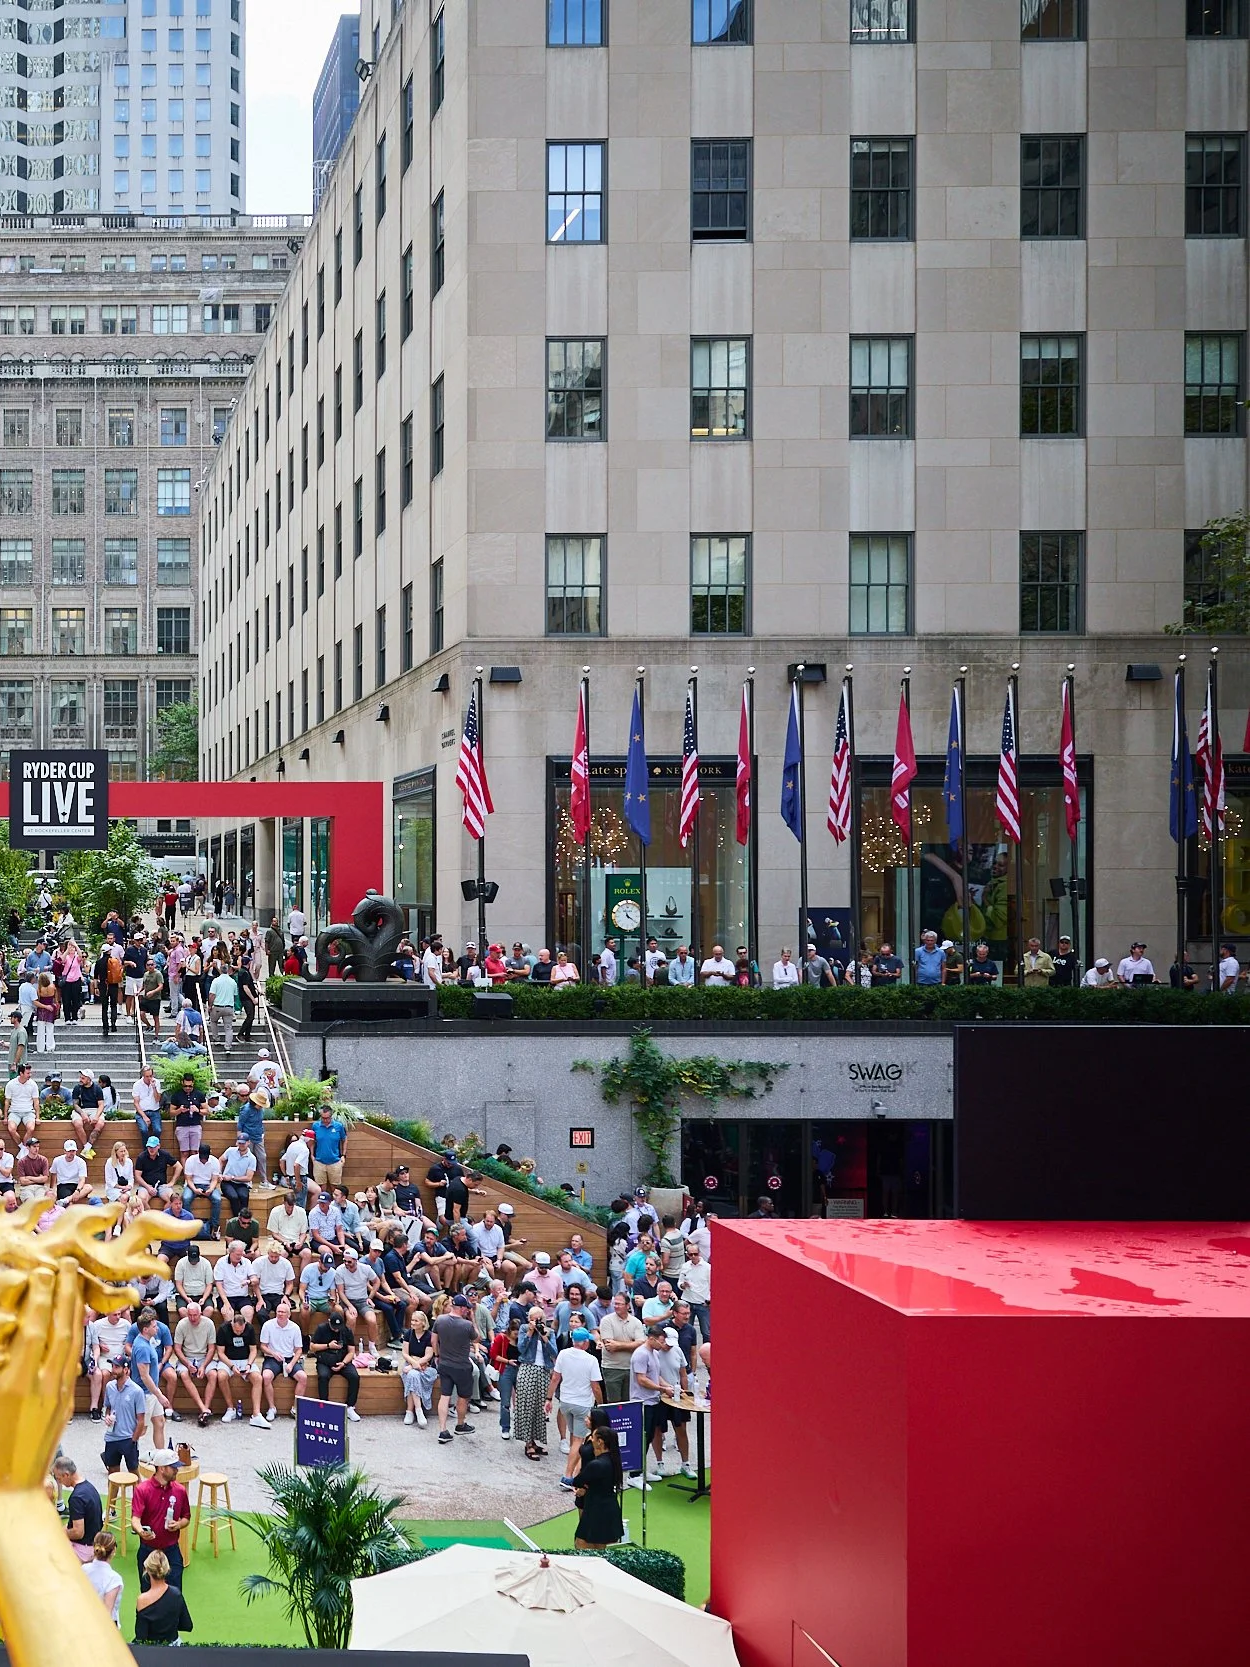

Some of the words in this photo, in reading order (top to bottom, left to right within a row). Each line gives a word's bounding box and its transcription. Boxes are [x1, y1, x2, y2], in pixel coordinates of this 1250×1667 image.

[23, 762, 67, 779] RYDER
[69, 762, 95, 779] CUP
[666, 767, 682, 775] NE
[700, 767, 722, 775] ORK
[23, 781, 95, 824] LIVE
[848, 1063, 902, 1081] SWAG
[573, 1131, 591, 1144] EXIT
[304, 1419, 326, 1429] MUST
[305, 1433, 316, 1441] TO
[318, 1436, 338, 1445] PLAY
